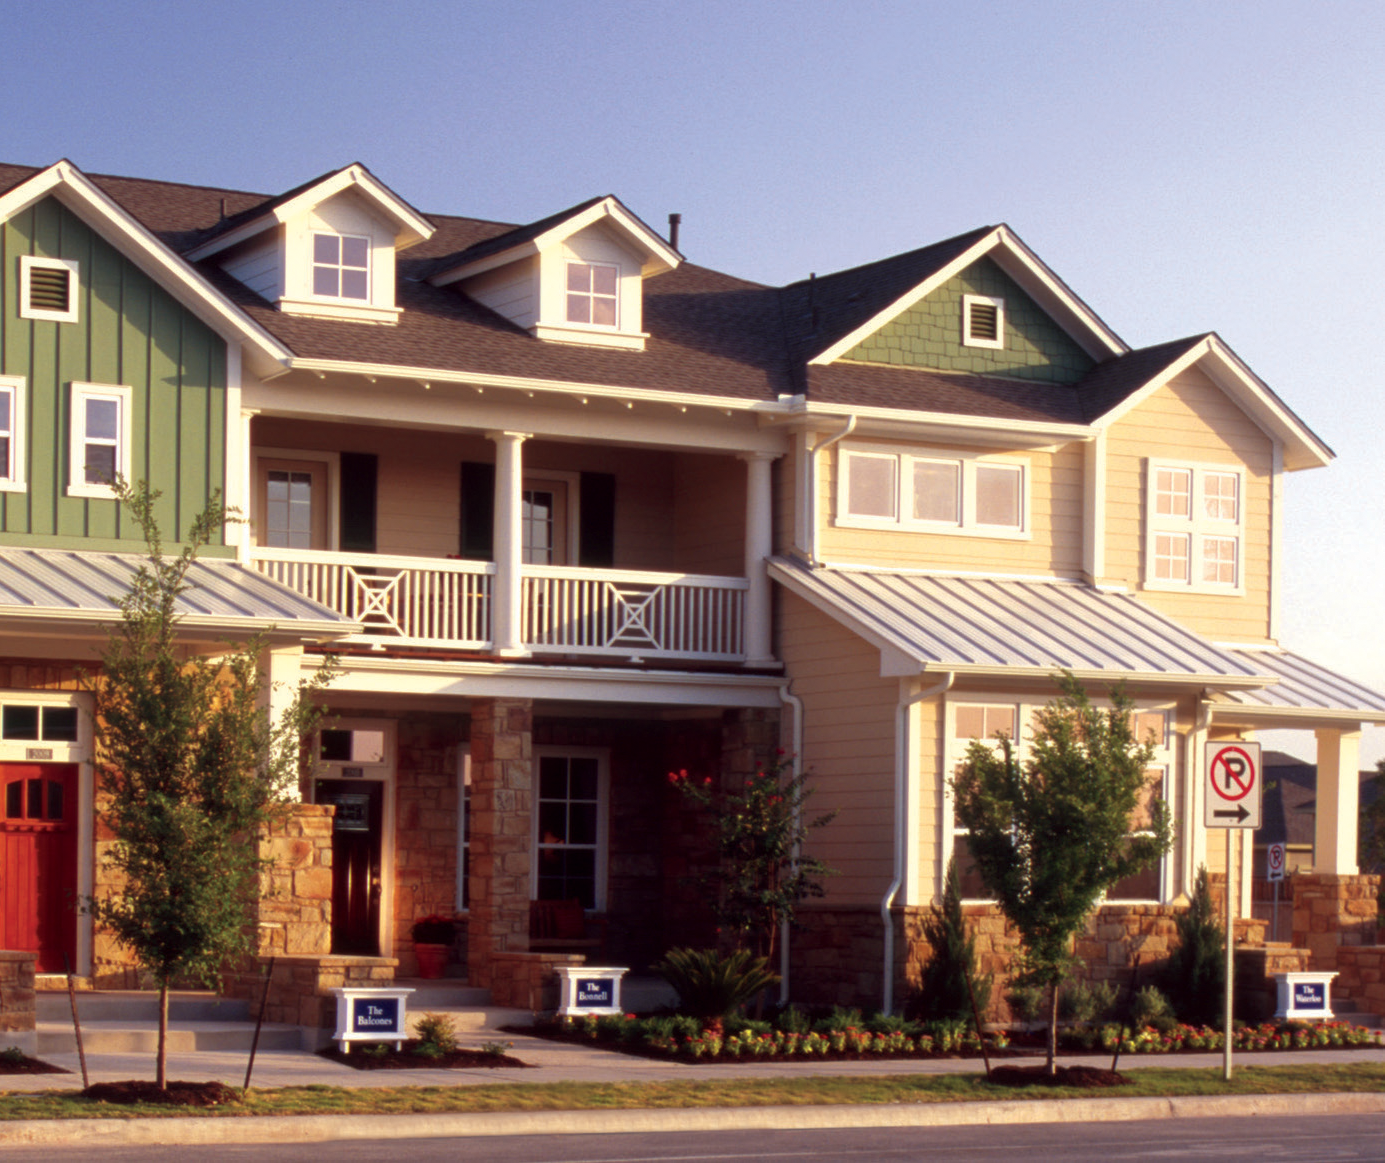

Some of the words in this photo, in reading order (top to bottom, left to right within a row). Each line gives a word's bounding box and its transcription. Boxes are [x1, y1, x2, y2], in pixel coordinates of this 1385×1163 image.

[1225, 757, 1246, 789] P
[587, 982, 600, 991] The
[1303, 985, 1314, 994] The
[579, 991, 608, 1001] Bonnell
[367, 1005, 383, 1015] The
[358, 1015, 393, 1026] Balcones
